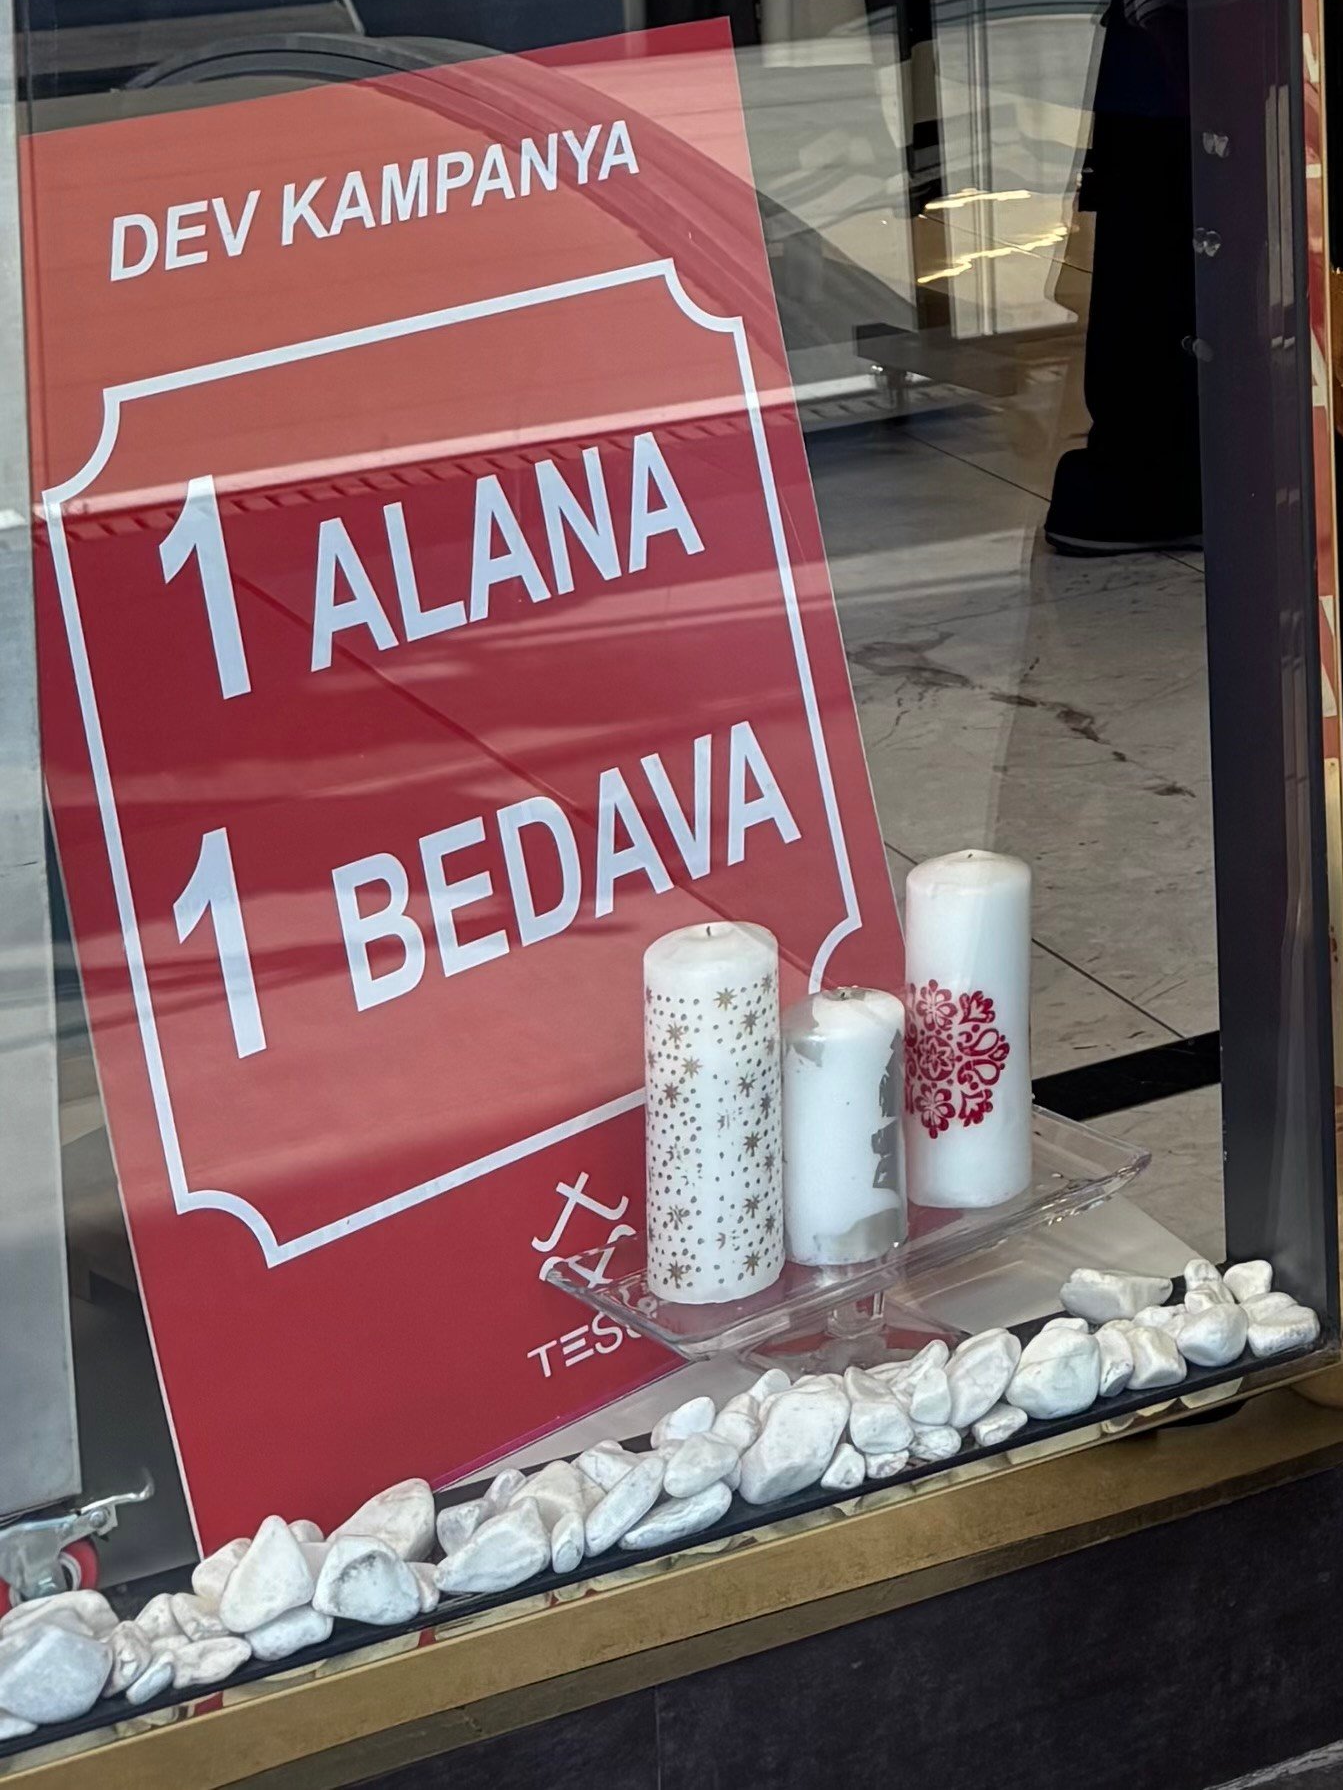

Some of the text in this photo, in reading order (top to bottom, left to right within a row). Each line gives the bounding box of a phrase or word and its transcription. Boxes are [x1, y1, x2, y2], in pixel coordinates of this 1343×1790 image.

[108, 118, 641, 283] DEV KAMPANYA
[158, 430, 706, 701] 1 ALANA
[171, 719, 803, 1061] 1 BEDAVA
